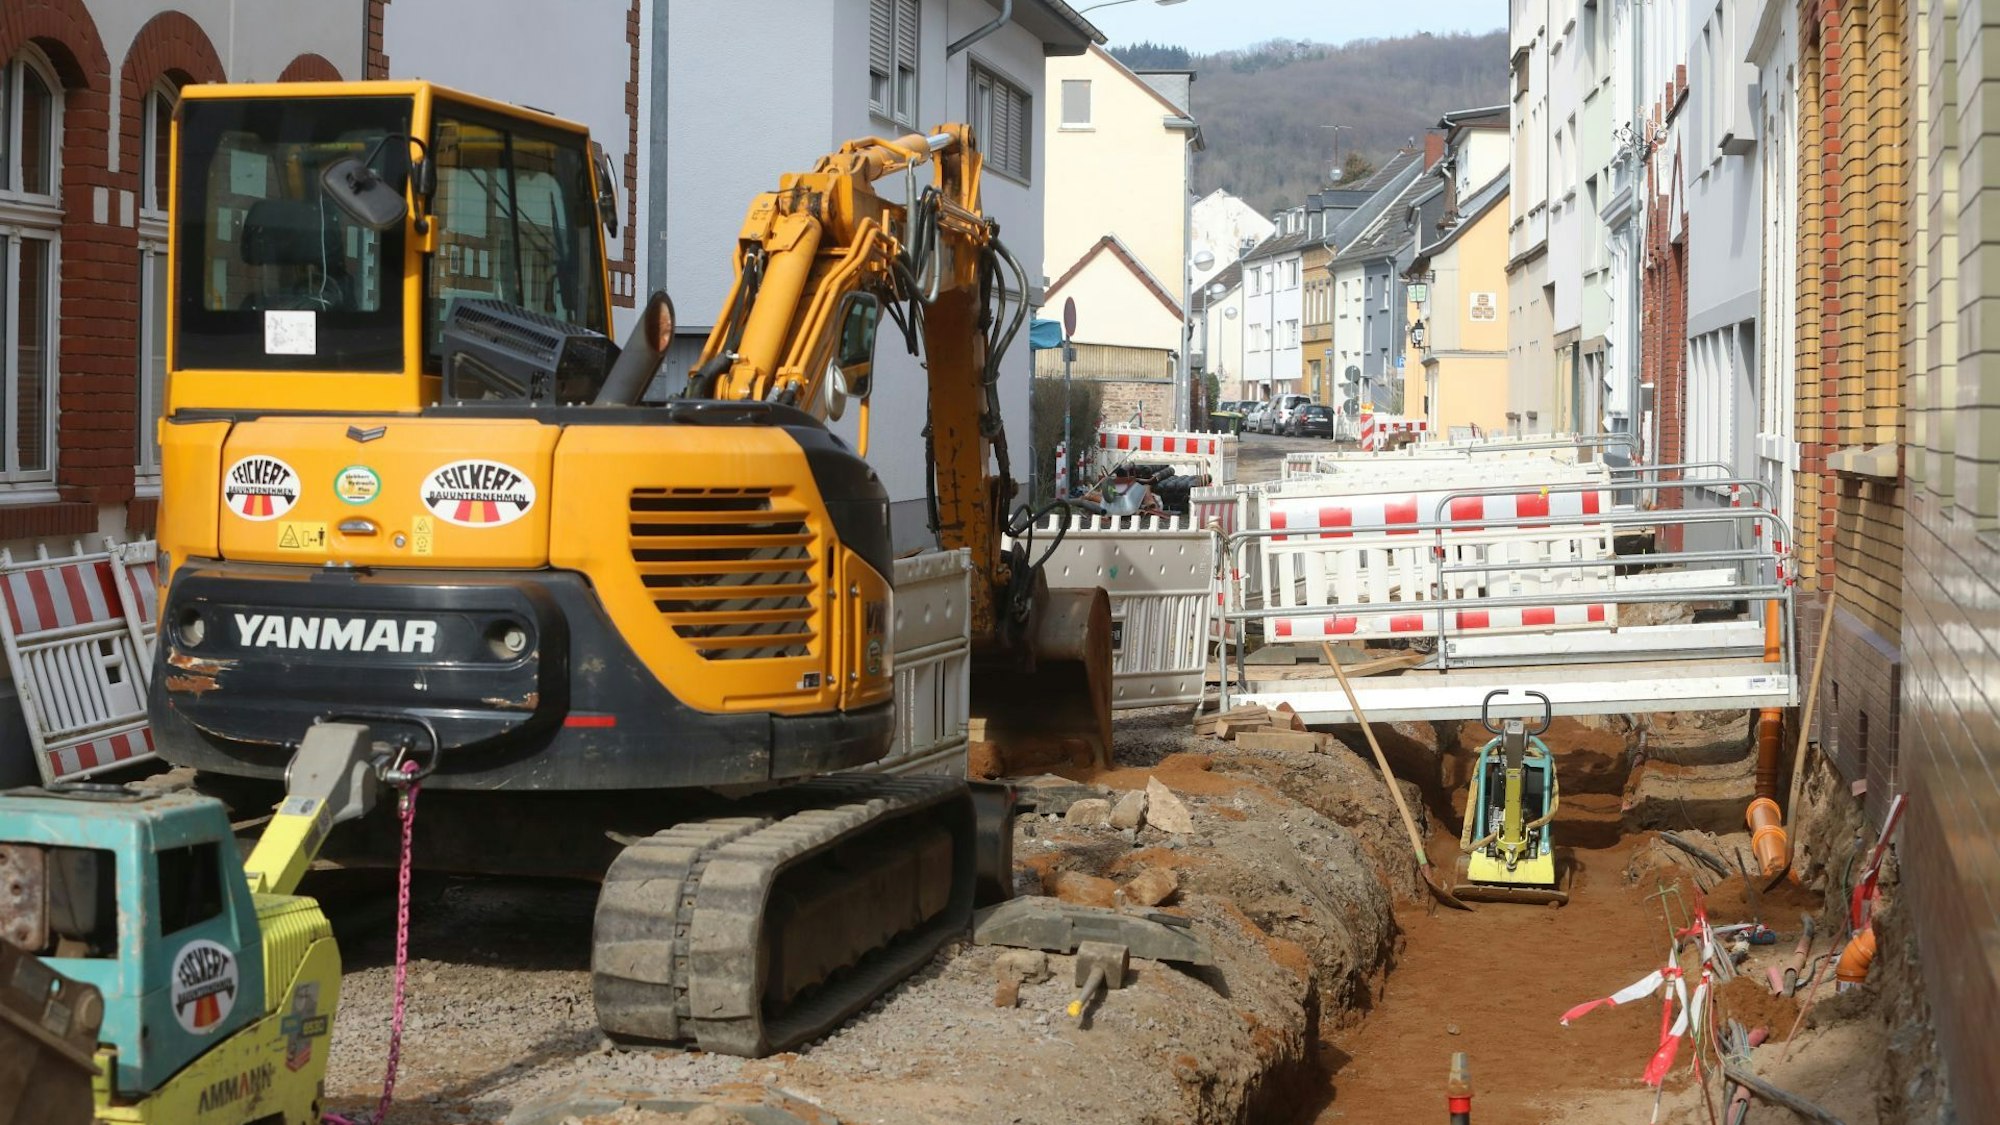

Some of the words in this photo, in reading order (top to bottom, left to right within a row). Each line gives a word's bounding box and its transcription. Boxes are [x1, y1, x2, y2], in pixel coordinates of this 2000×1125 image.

[232, 459, 291, 485] FEICKERT
[434, 464, 522, 491] FEICKERT
[228, 486, 294, 495] BAUUNTERNEHMEN
[429, 491, 526, 502] BAUUNTERNEHMEN
[234, 613, 438, 654] YANMAR
[179, 947, 230, 989] FEICKERT
[198, 1062, 272, 1115] AMMANN
